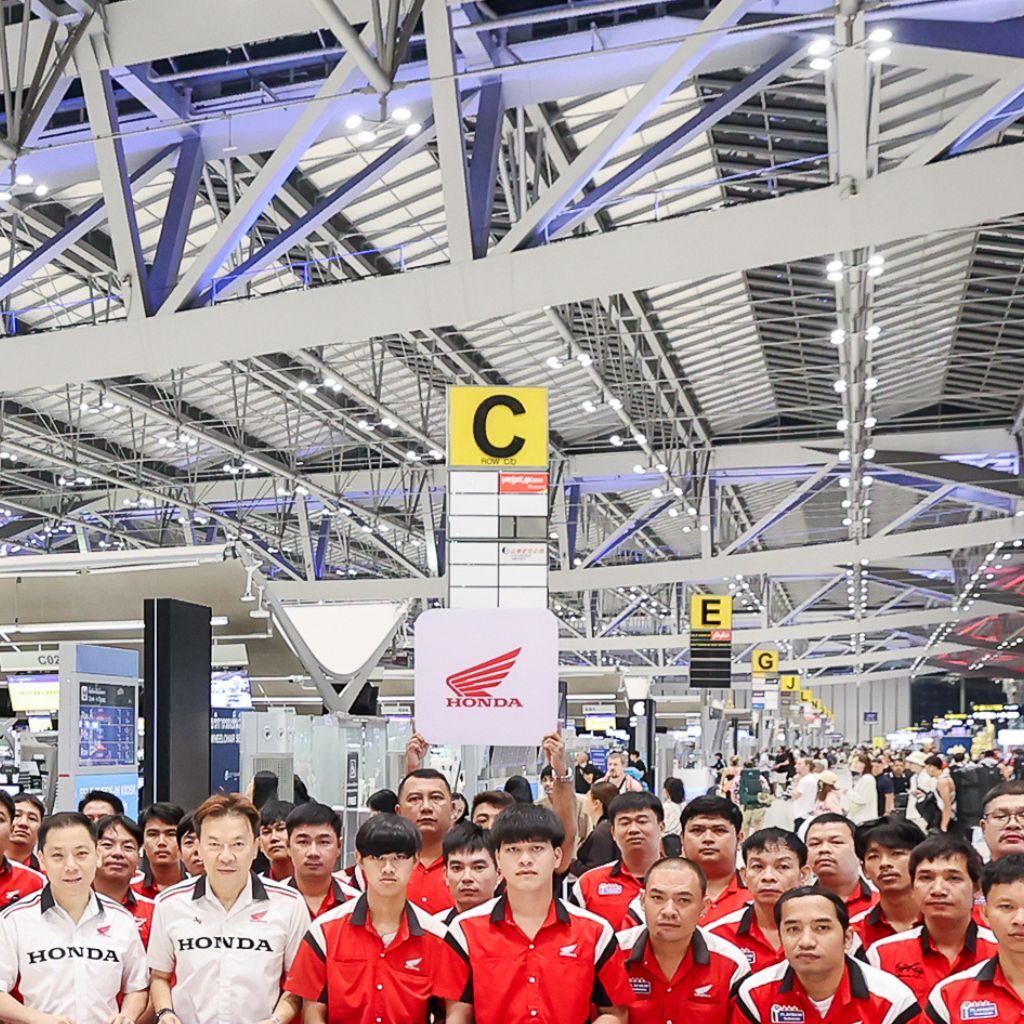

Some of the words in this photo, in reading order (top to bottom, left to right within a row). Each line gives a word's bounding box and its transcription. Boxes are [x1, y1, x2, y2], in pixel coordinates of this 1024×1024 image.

[473, 394, 526, 458] C
[701, 599, 721, 625] E
[758, 653, 773, 670] G
[786, 677, 795, 689] J
[445, 696, 524, 708] HONDA
[177, 936, 274, 953] HONDA
[28, 947, 120, 964] HONDA
